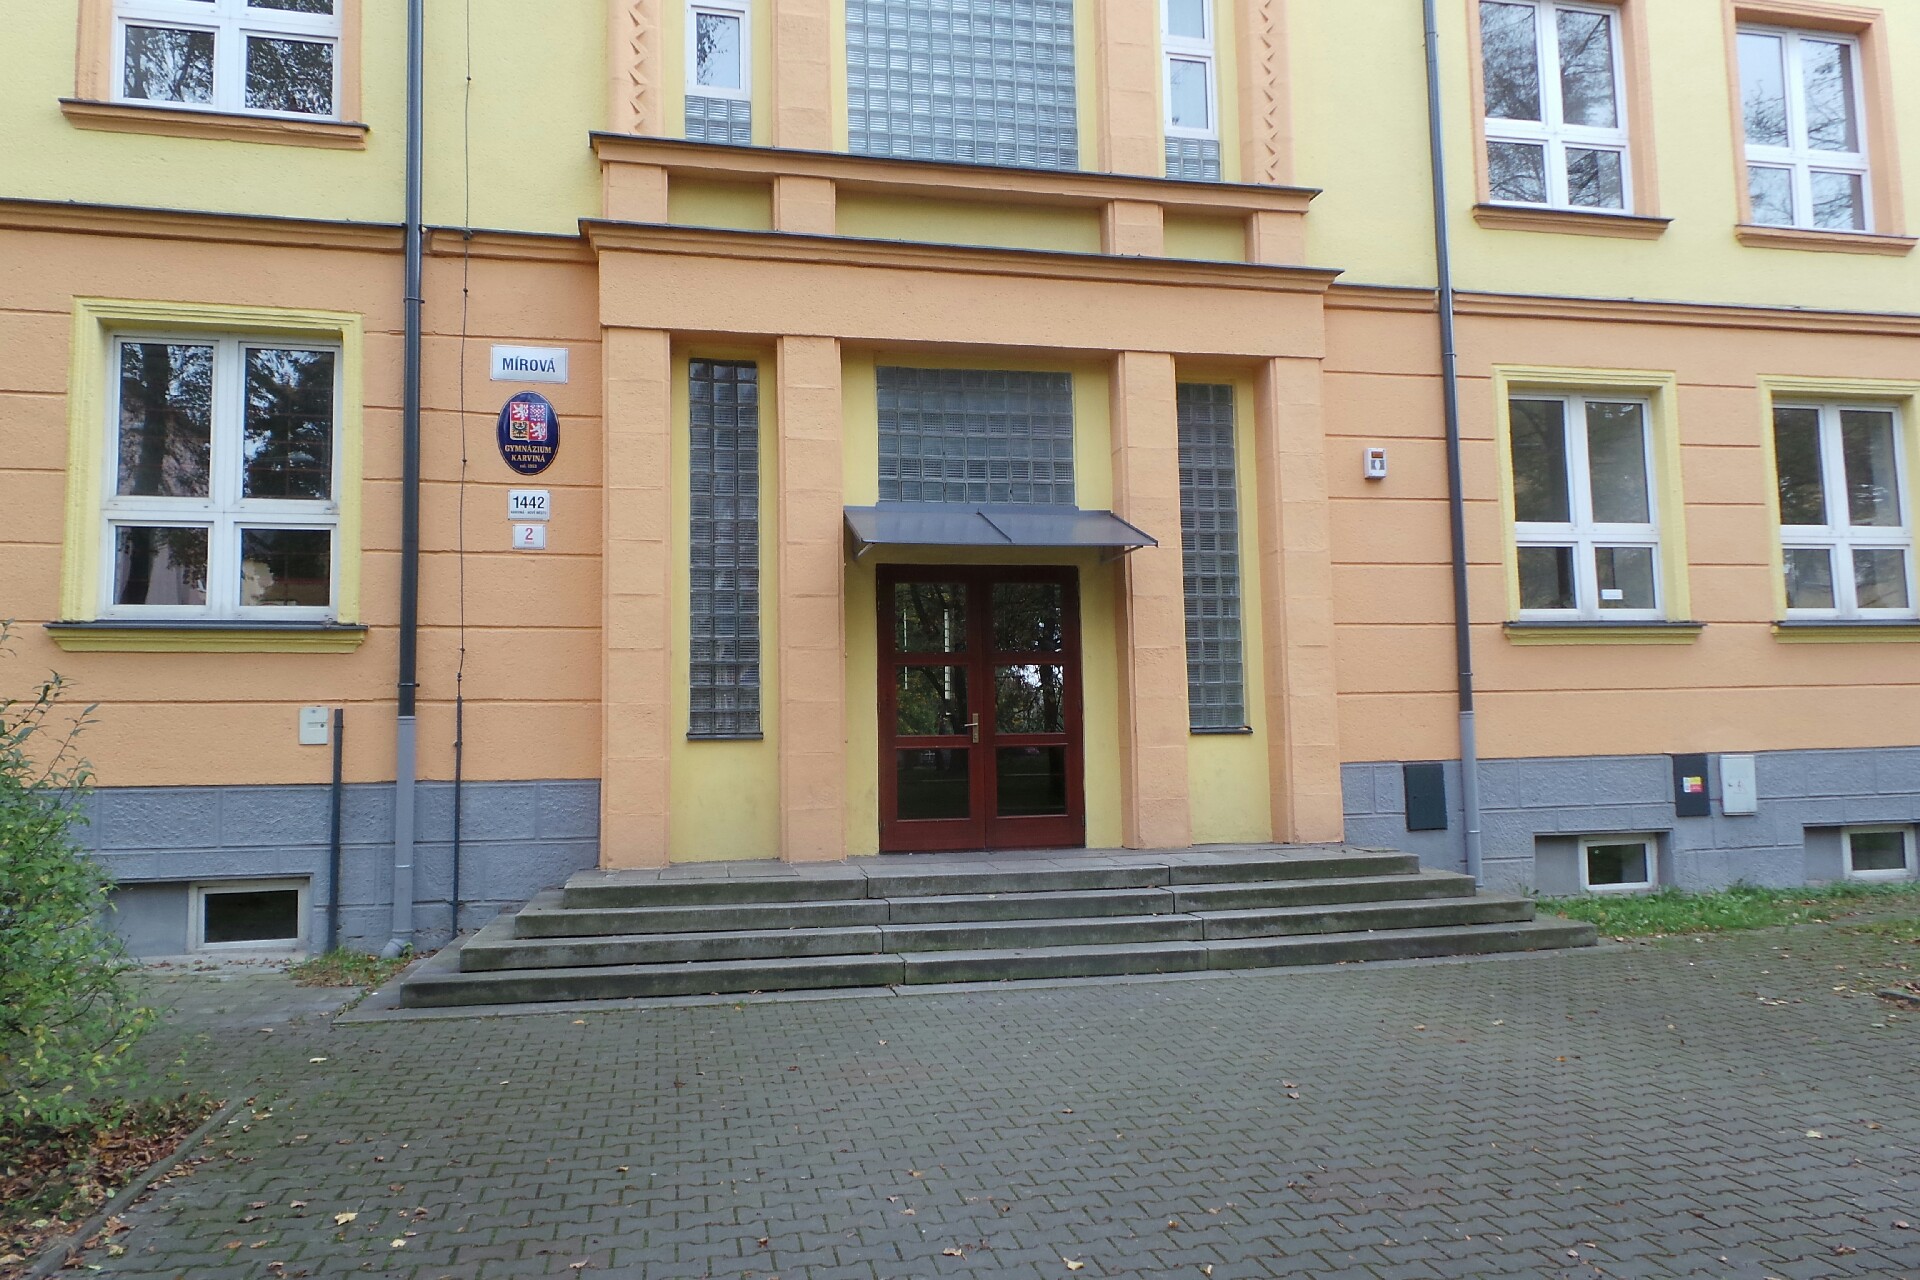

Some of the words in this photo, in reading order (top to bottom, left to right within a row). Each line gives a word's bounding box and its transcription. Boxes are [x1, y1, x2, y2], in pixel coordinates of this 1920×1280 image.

[502, 356, 556, 373] MÍROVÁ
[504, 444, 552, 453] GYMNÁZIUM
[511, 454, 546, 463] KARVINÁ
[513, 496, 545, 508] 1442
[525, 527, 533, 540] 2
